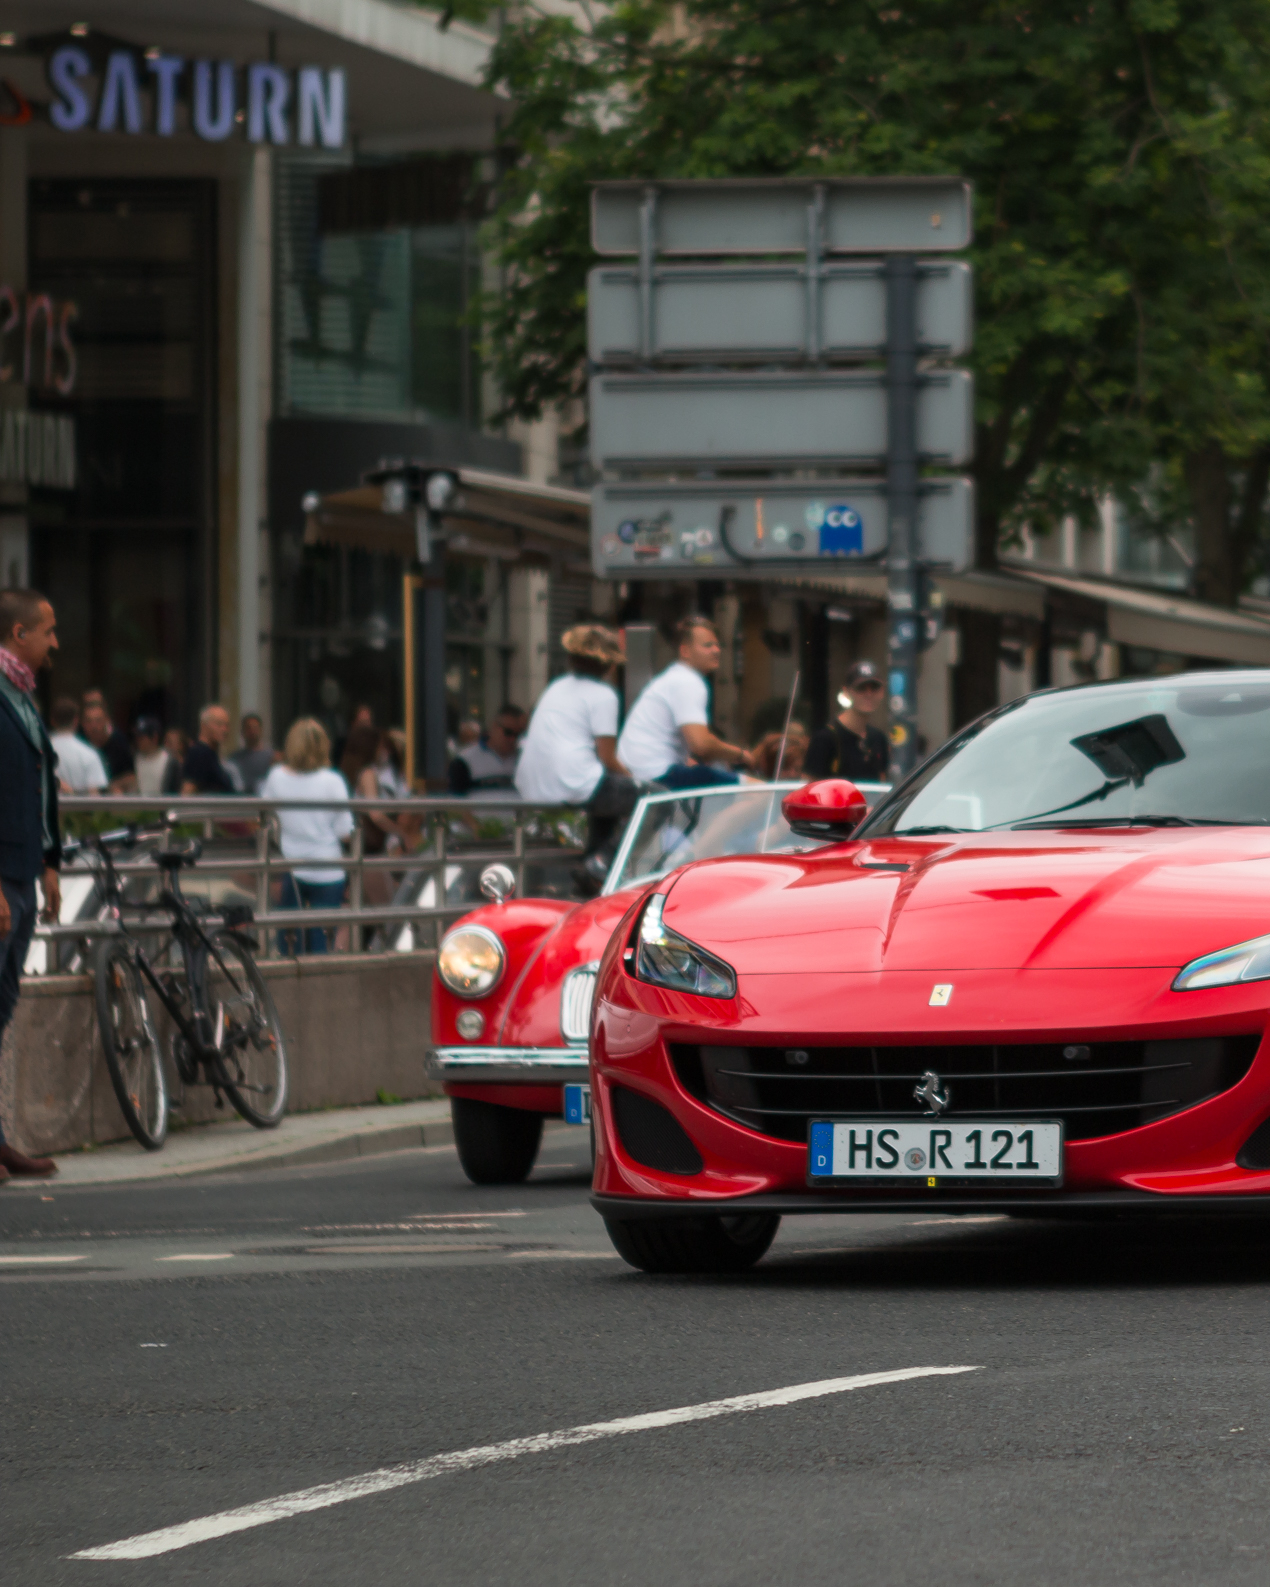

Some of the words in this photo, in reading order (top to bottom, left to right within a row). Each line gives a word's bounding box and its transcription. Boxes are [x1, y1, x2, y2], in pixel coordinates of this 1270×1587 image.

[49, 45, 347, 148] SATURN
[817, 1155, 827, 1167] D
[849, 1129, 900, 1169] HS
[929, 1129, 953, 1169] R
[964, 1129, 1040, 1170] 121
